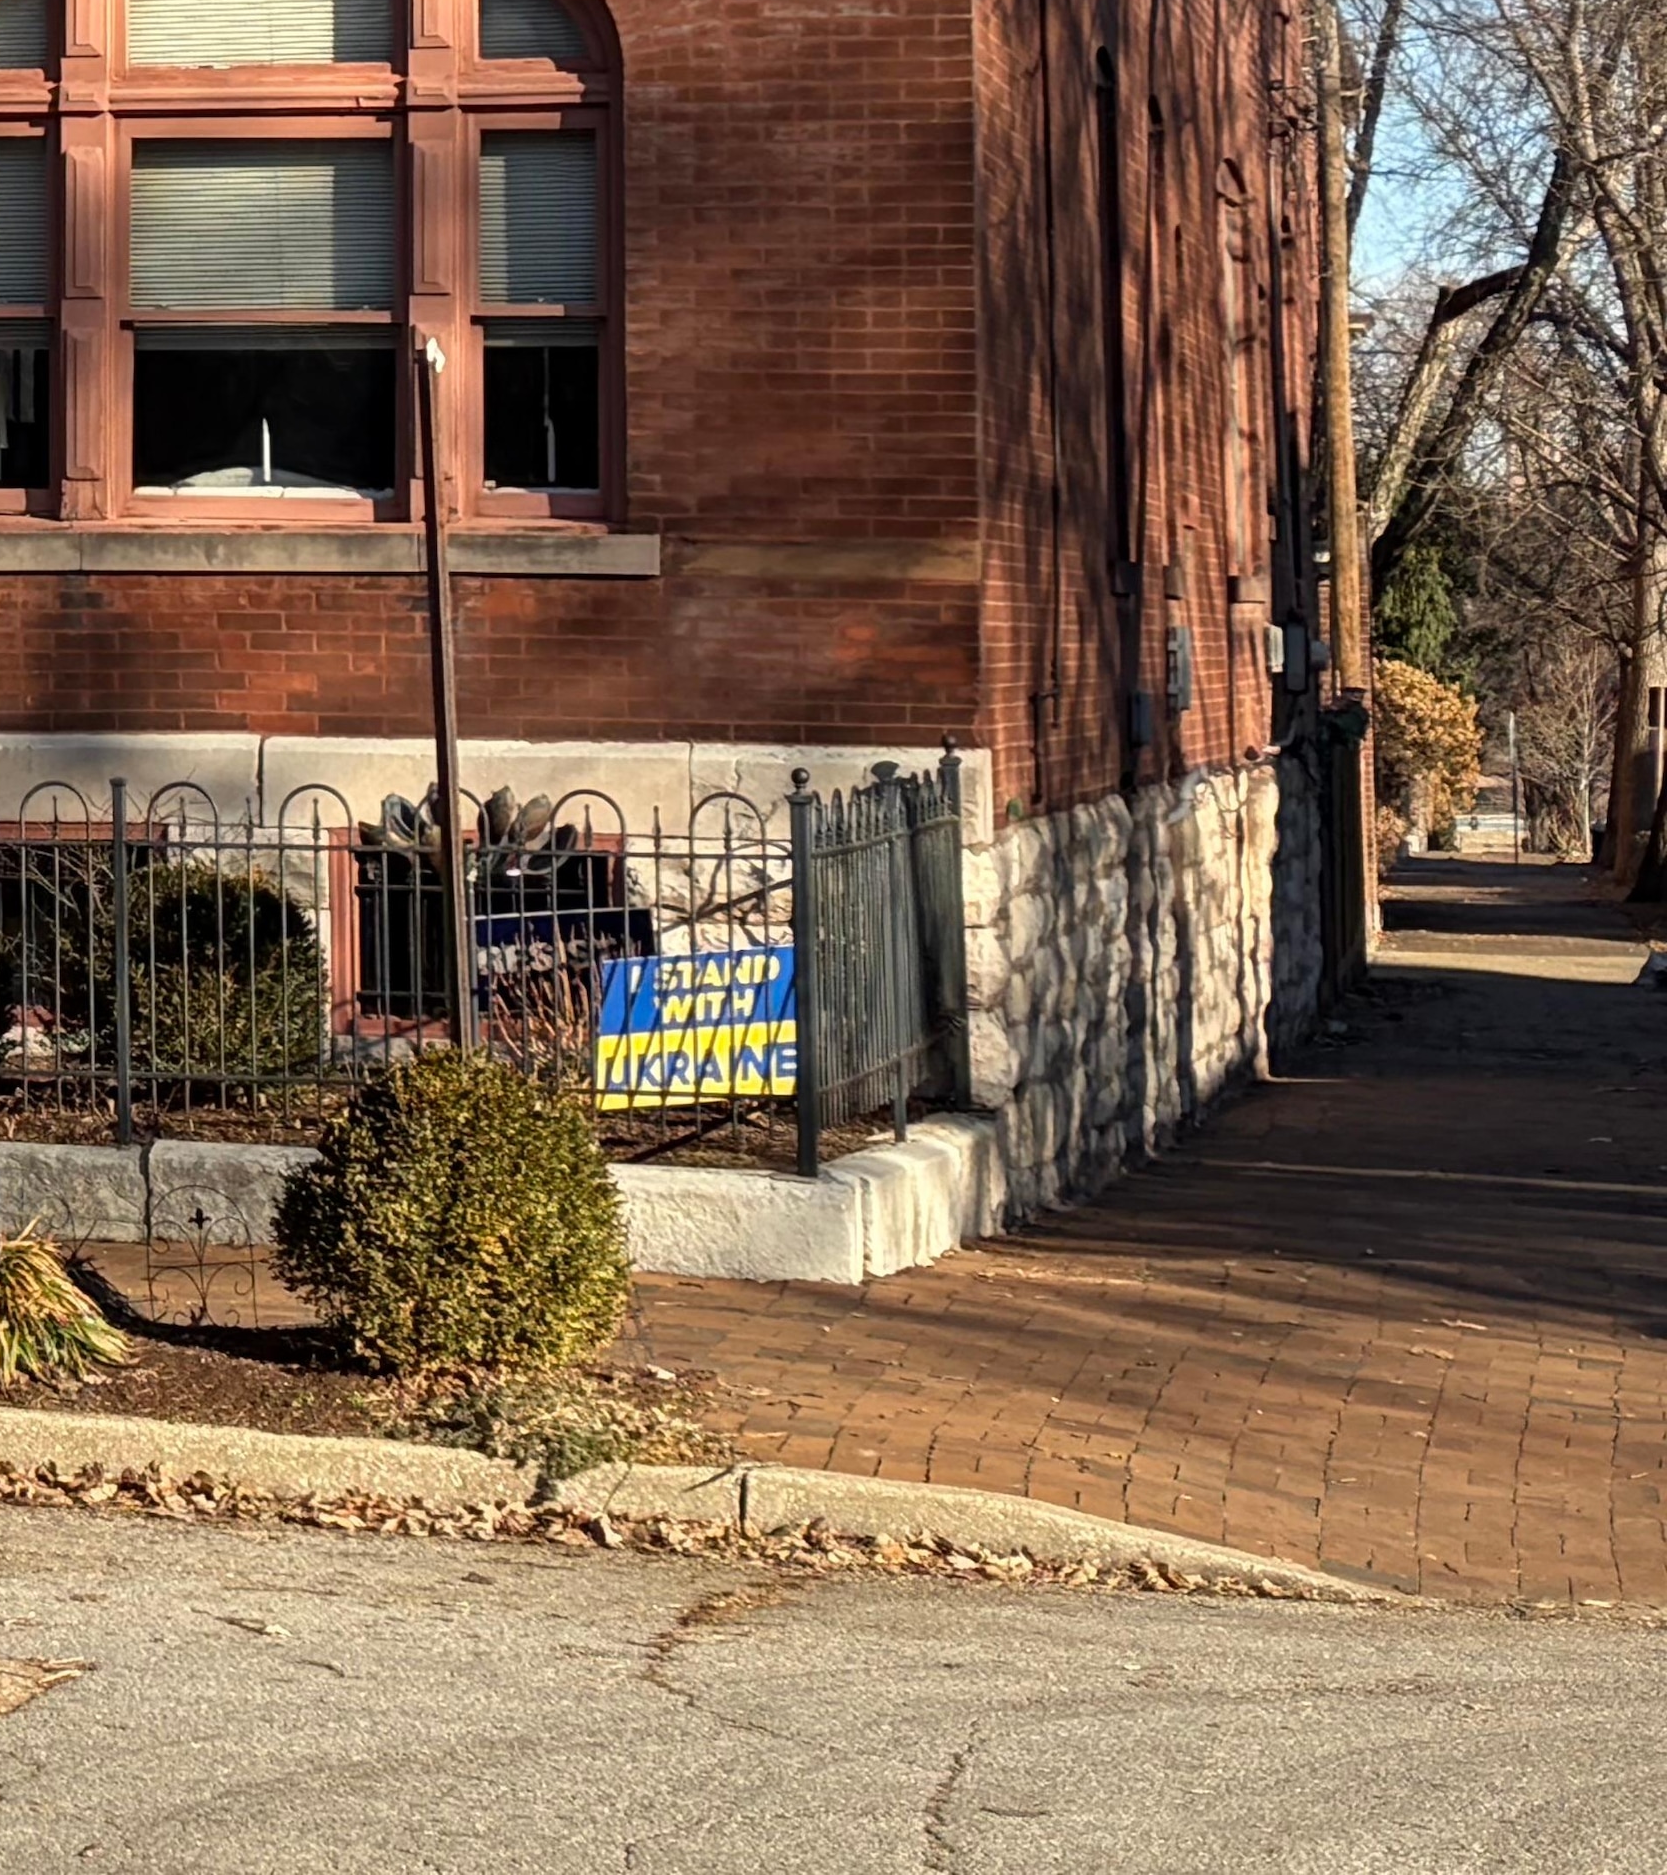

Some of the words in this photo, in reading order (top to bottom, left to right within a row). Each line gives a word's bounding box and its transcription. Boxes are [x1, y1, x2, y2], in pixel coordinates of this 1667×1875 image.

[653, 954, 780, 992] STAND
[653, 988, 755, 1024] WITH
[605, 1042, 798, 1092] UKRANE
